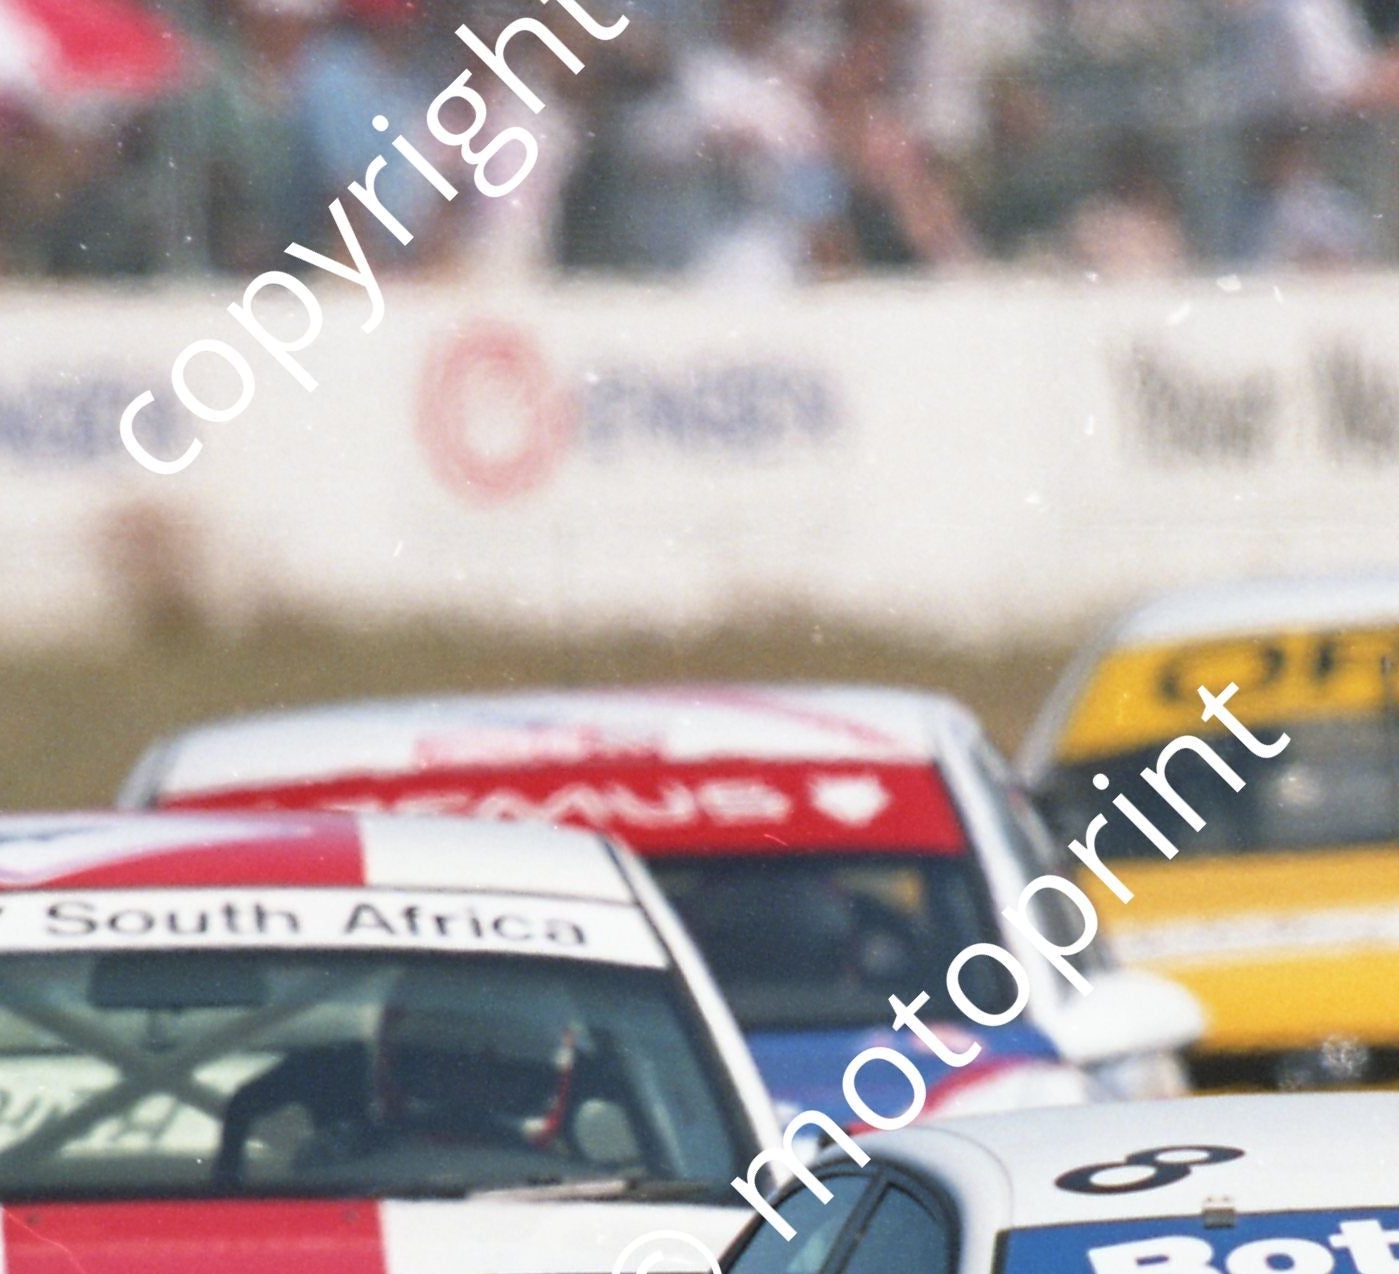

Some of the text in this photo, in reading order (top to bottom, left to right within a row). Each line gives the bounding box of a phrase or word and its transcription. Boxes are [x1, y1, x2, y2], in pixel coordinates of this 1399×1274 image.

[45, 898, 303, 940] South
[341, 901, 588, 949] Africa
[1053, 1143, 1247, 1196] 8
